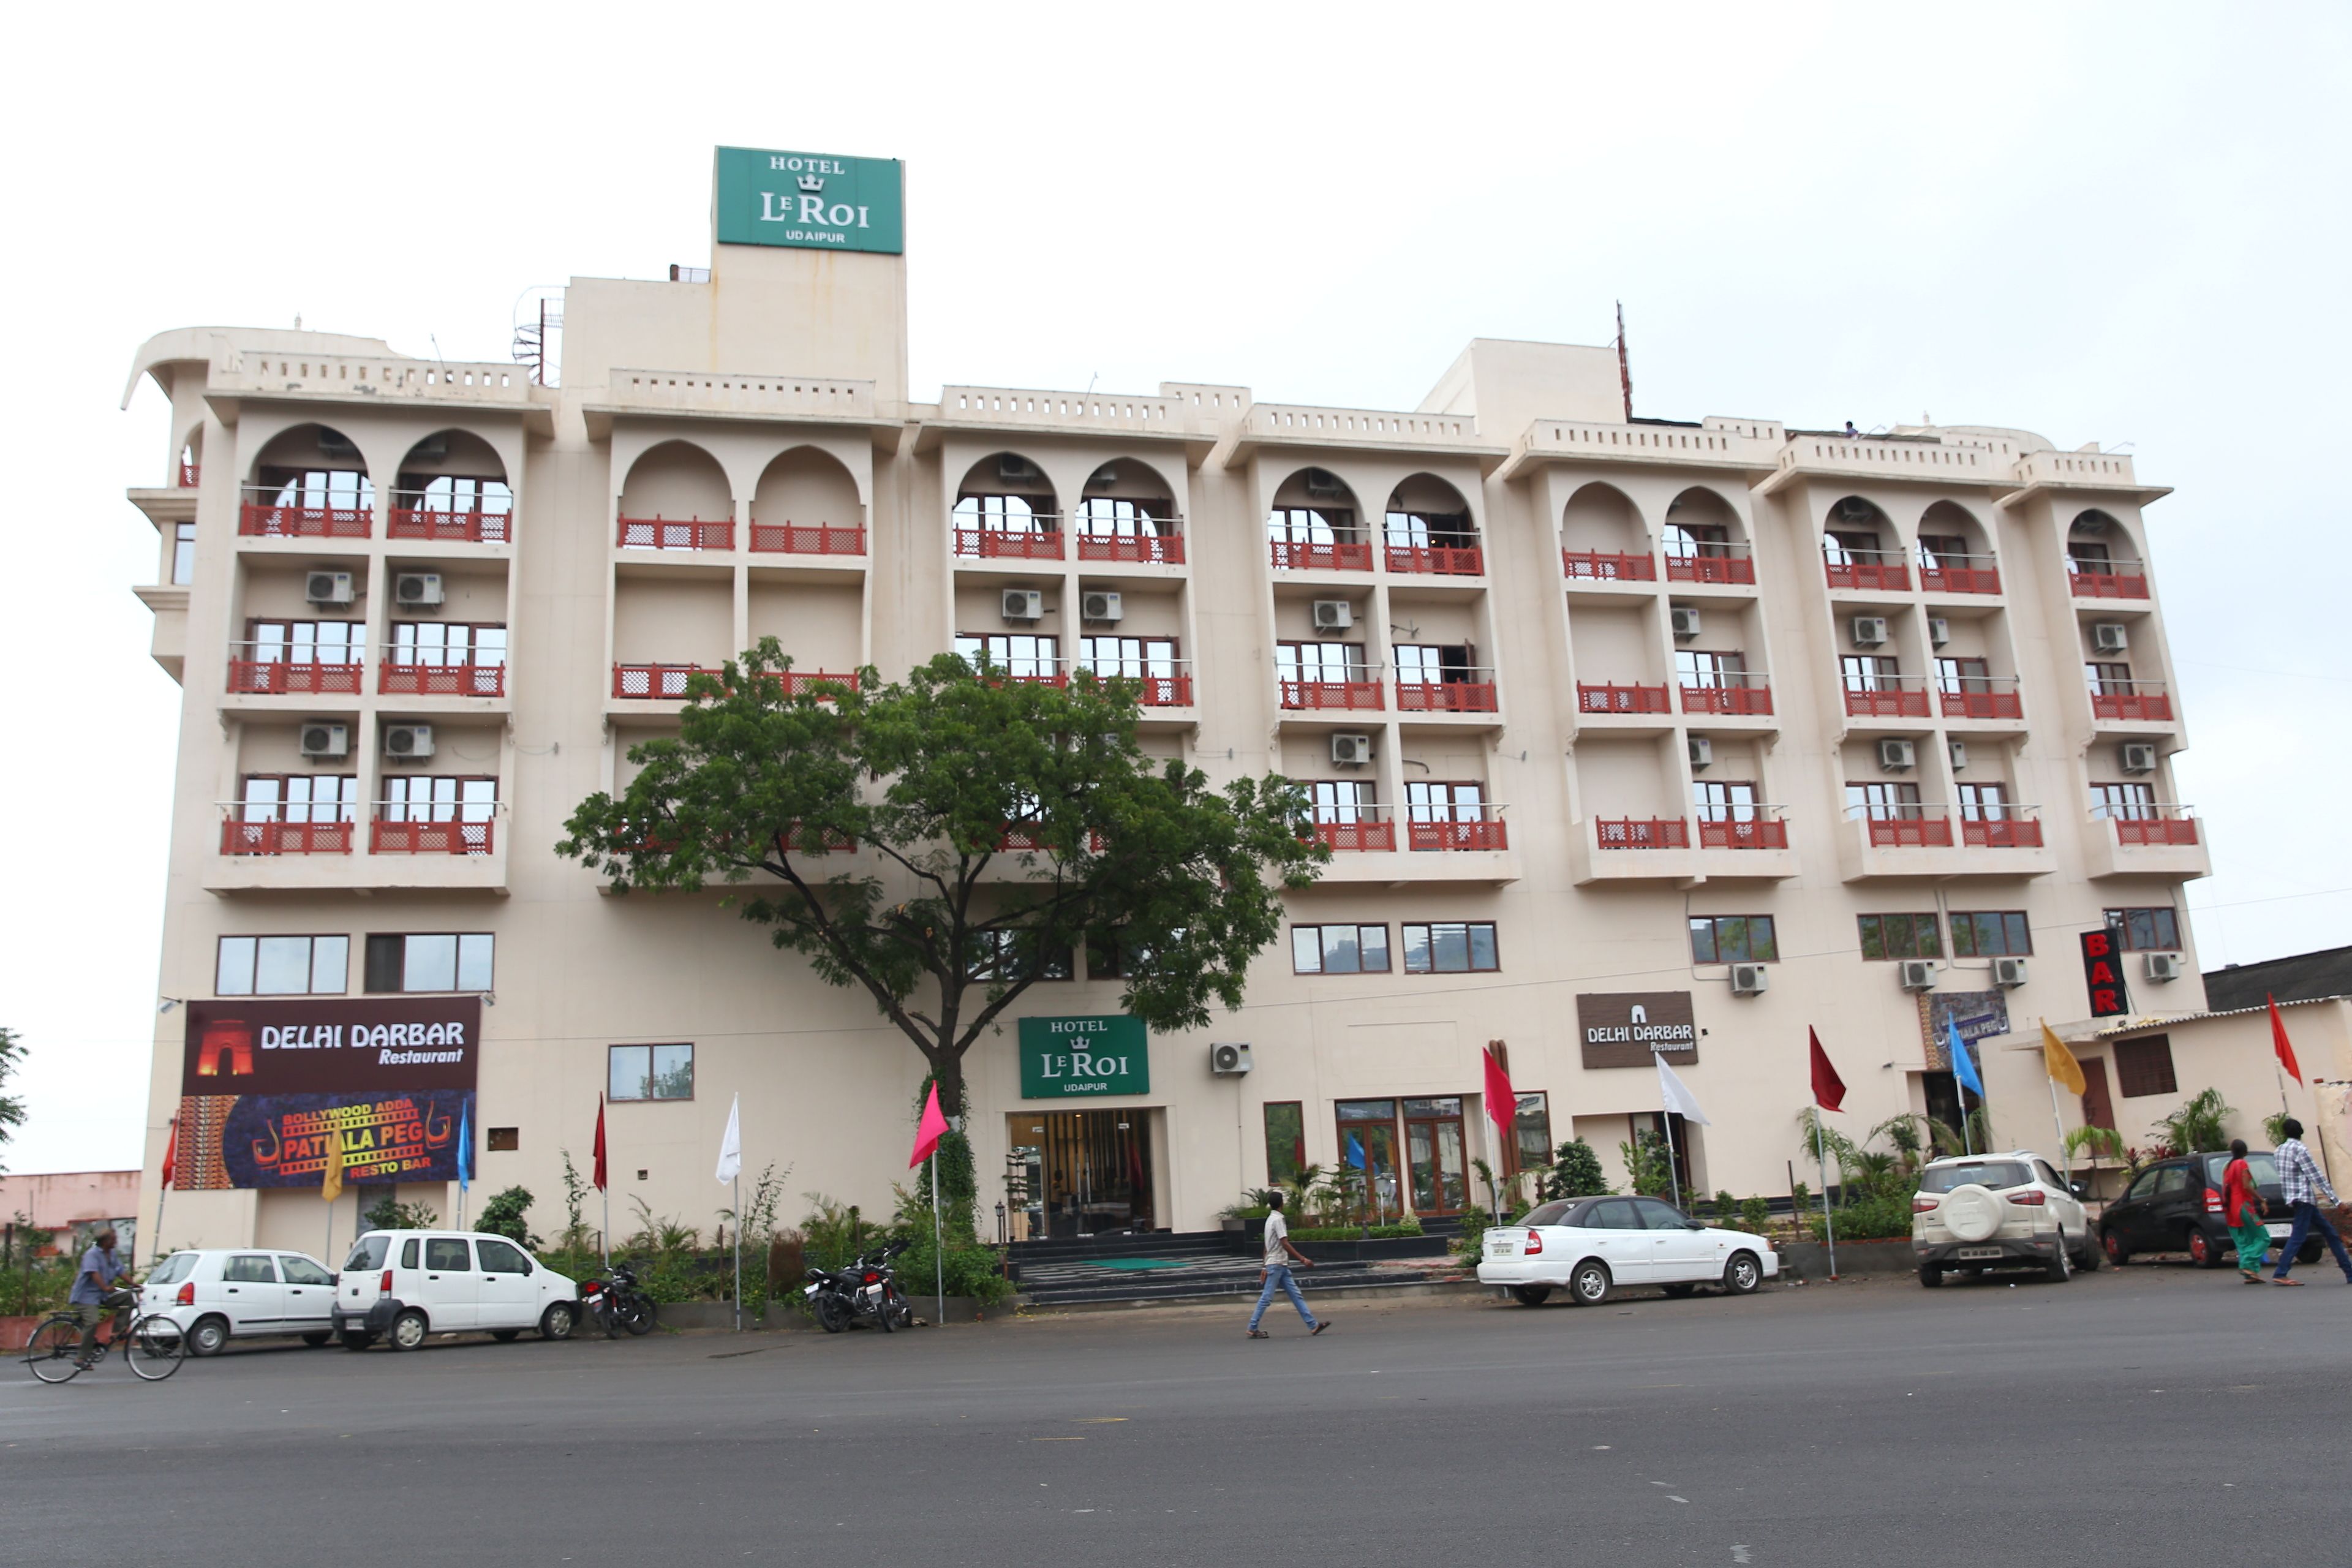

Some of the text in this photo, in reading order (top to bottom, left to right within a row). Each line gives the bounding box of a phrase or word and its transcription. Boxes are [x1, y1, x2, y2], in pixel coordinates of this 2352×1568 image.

[770, 156, 845, 175] HOTEL
[785, 230, 845, 243] UDAIPUR
[2086, 933, 2119, 1012] BAR
[1050, 1020, 1107, 1032] HOTEL
[1588, 1025, 1693, 1042] DELHI DARBAR
[261, 1022, 464, 1049] DELHI DARBAR
[1650, 1041, 1693, 1052] Restaurant
[379, 1048, 464, 1065] Restaurant
[1064, 1083, 1107, 1091] UDAIPUR
[282, 1098, 414, 1125] BOLLYWOOD ADDA
[380, 1121, 423, 1145] PEG
[350, 1157, 431, 1178] RESTO BAR
